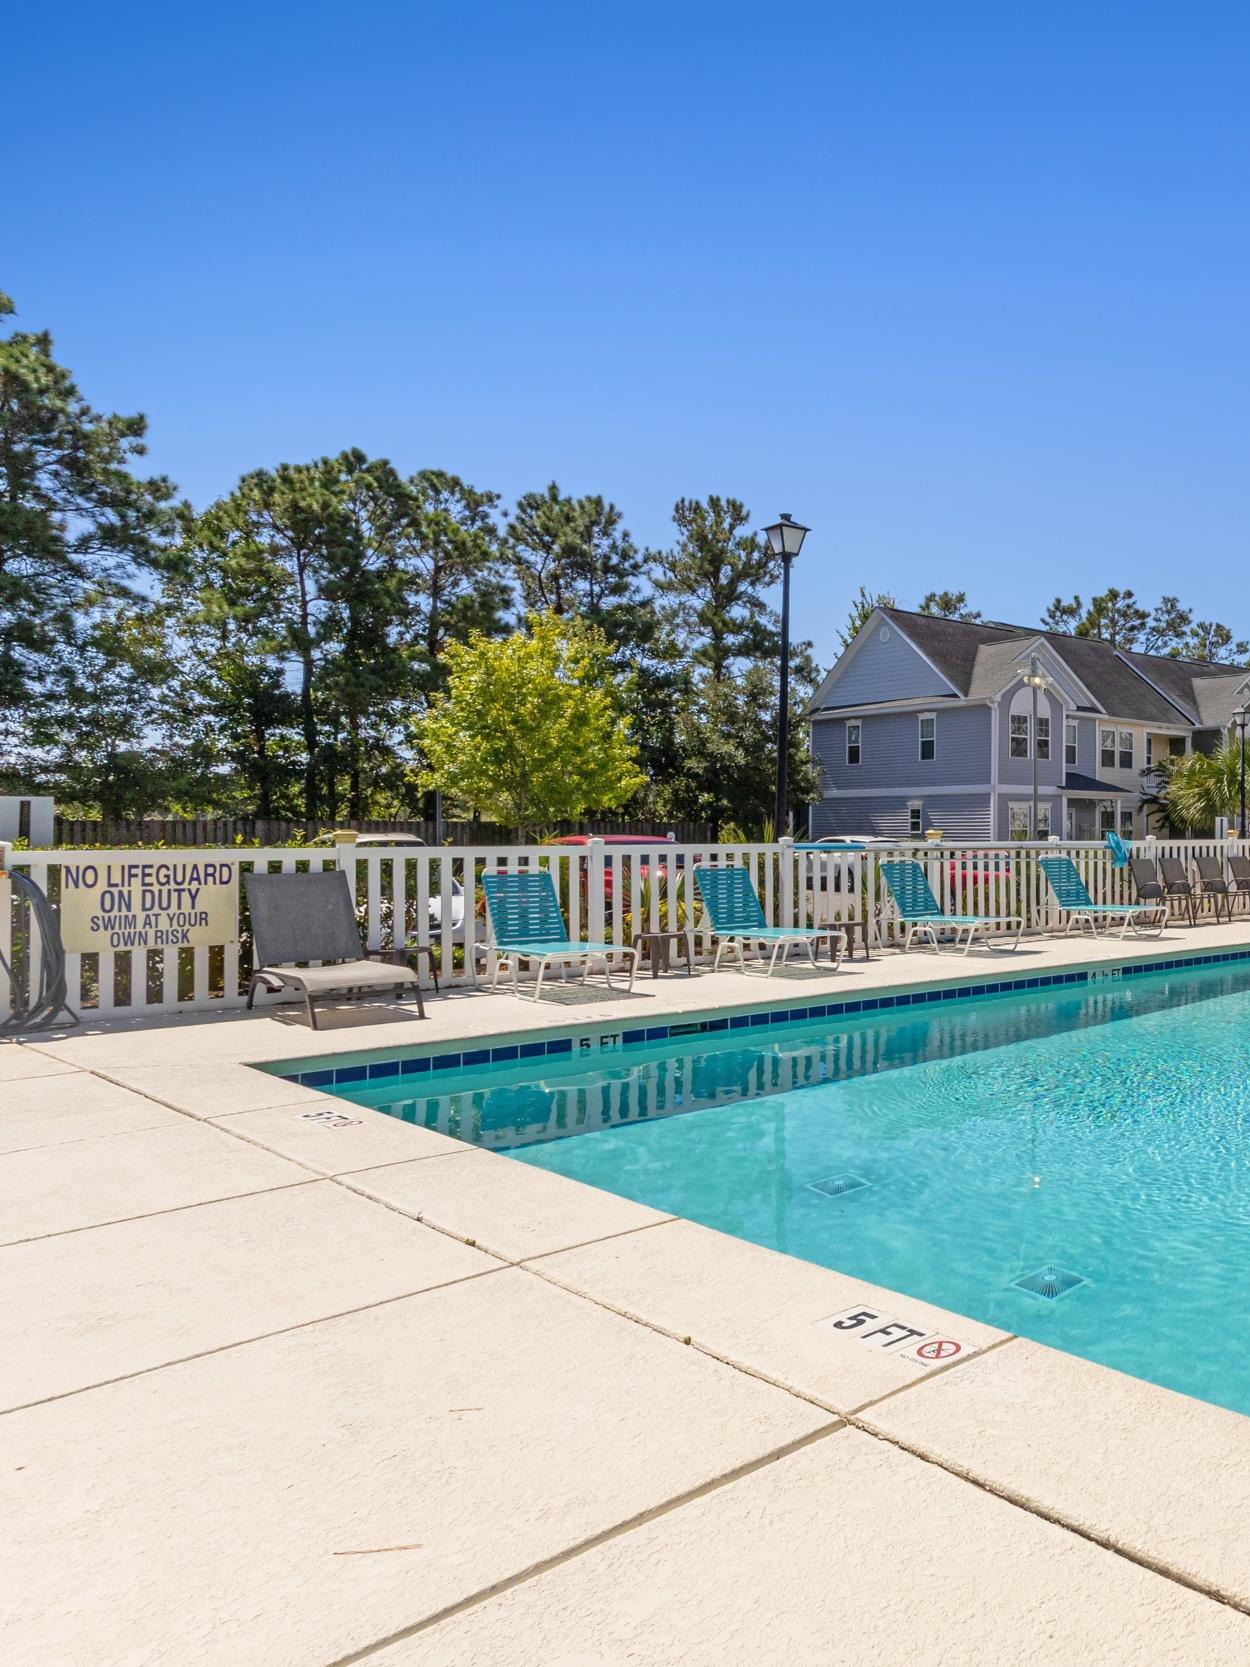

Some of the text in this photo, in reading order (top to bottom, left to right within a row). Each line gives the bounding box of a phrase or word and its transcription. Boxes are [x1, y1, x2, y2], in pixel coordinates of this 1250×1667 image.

[64, 863, 232, 889] NO LIFEGUARD
[101, 888, 200, 913] ON DUTY
[90, 911, 209, 932] SWIM AT YOUR
[110, 928, 190, 948] OWN RISK
[580, 1034, 620, 1049] 5 FT
[833, 1311, 926, 1347] 5 FT
